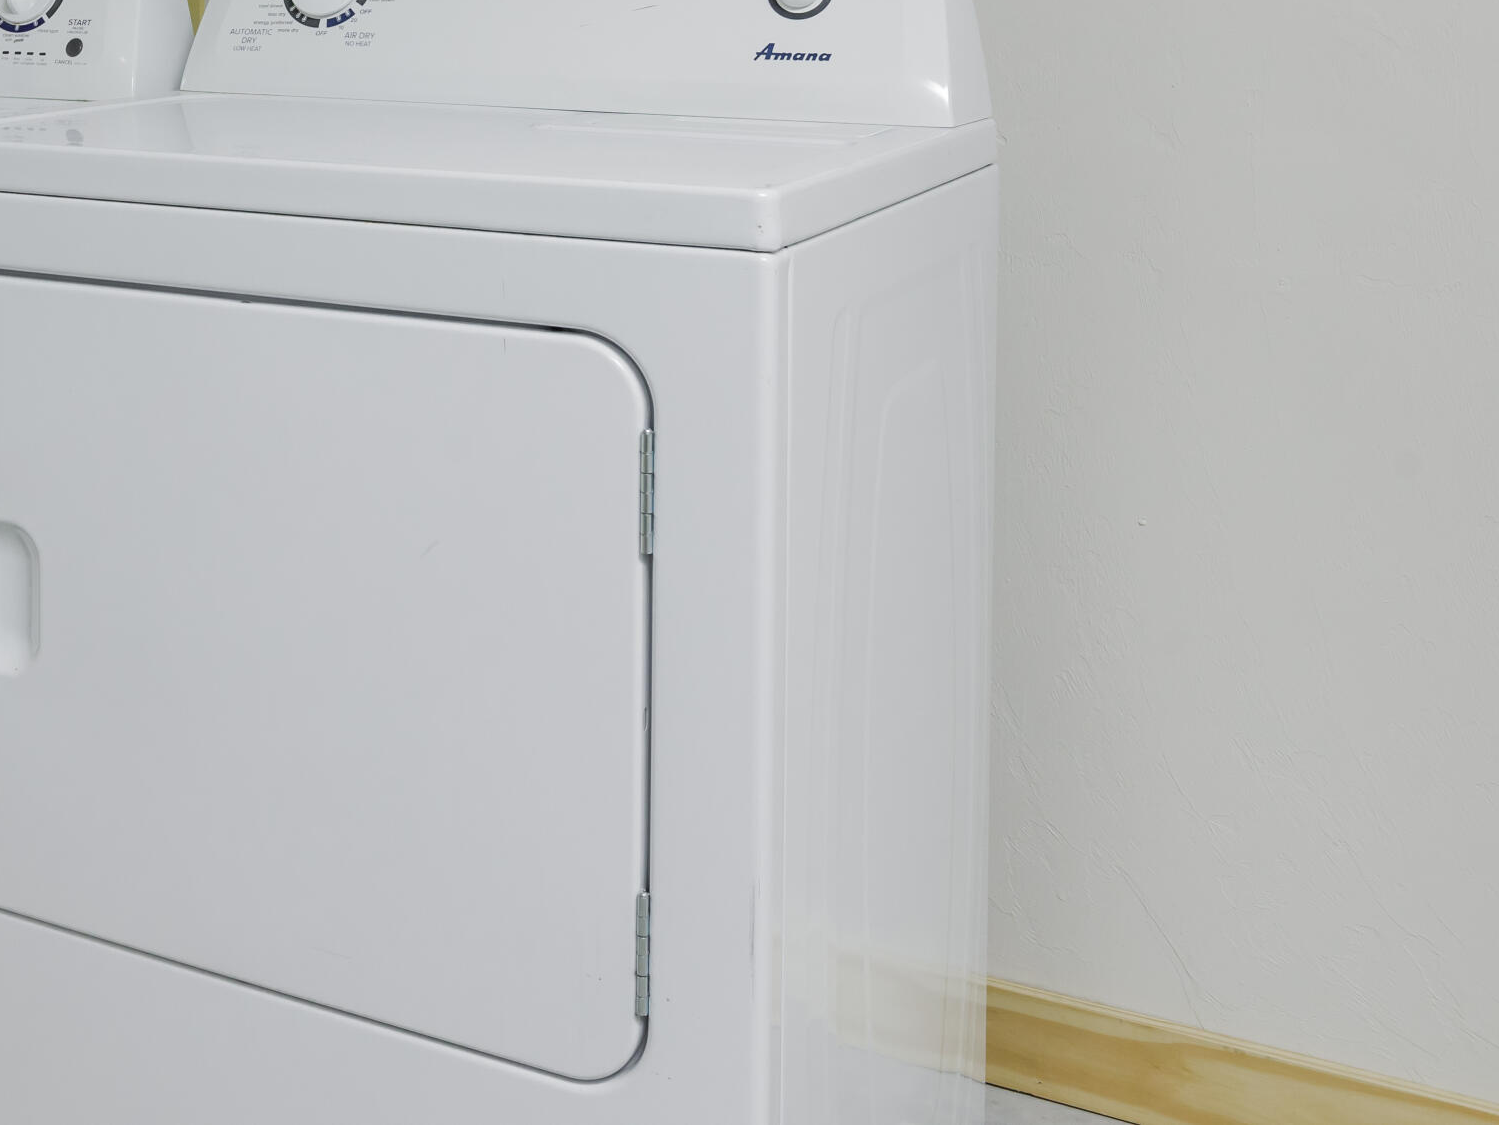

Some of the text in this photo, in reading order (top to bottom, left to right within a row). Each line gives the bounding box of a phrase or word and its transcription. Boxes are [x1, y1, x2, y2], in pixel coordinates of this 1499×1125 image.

[229, 28, 273, 36] AUTOMATIC
[358, 32, 375, 40] DRY
[753, 42, 832, 62] Amana
